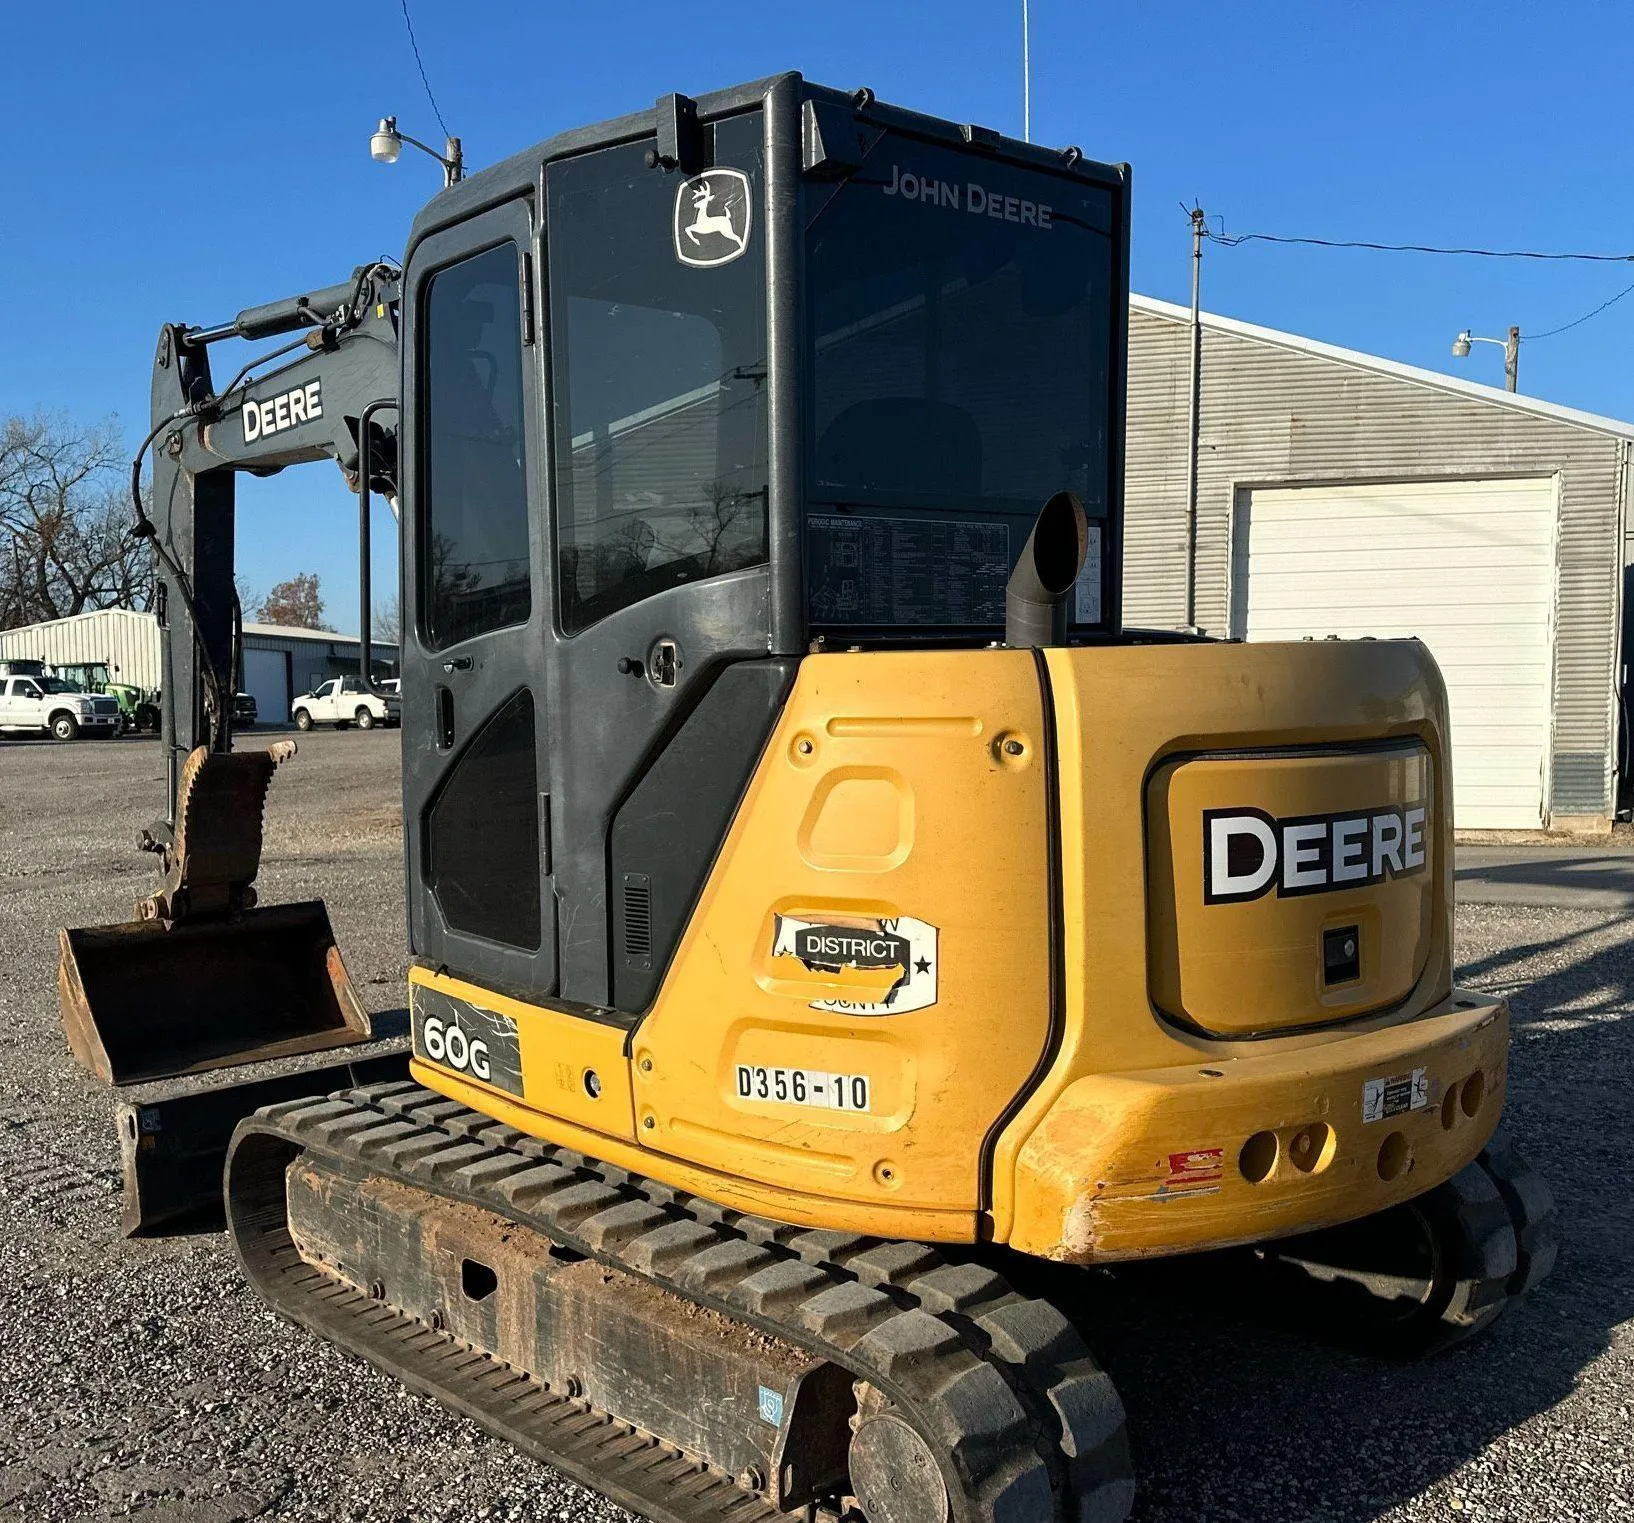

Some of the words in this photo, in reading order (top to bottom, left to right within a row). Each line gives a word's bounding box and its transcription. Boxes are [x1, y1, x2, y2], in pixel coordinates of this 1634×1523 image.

[883, 164, 959, 210] JOHN
[967, 182, 1053, 230] DEERE
[242, 380, 322, 442] DEERE
[1210, 807, 1426, 896] DEERE
[806, 936, 900, 959] DISTRICT
[423, 1015, 491, 1081] 60G
[738, 1066, 867, 1109] D356-10
